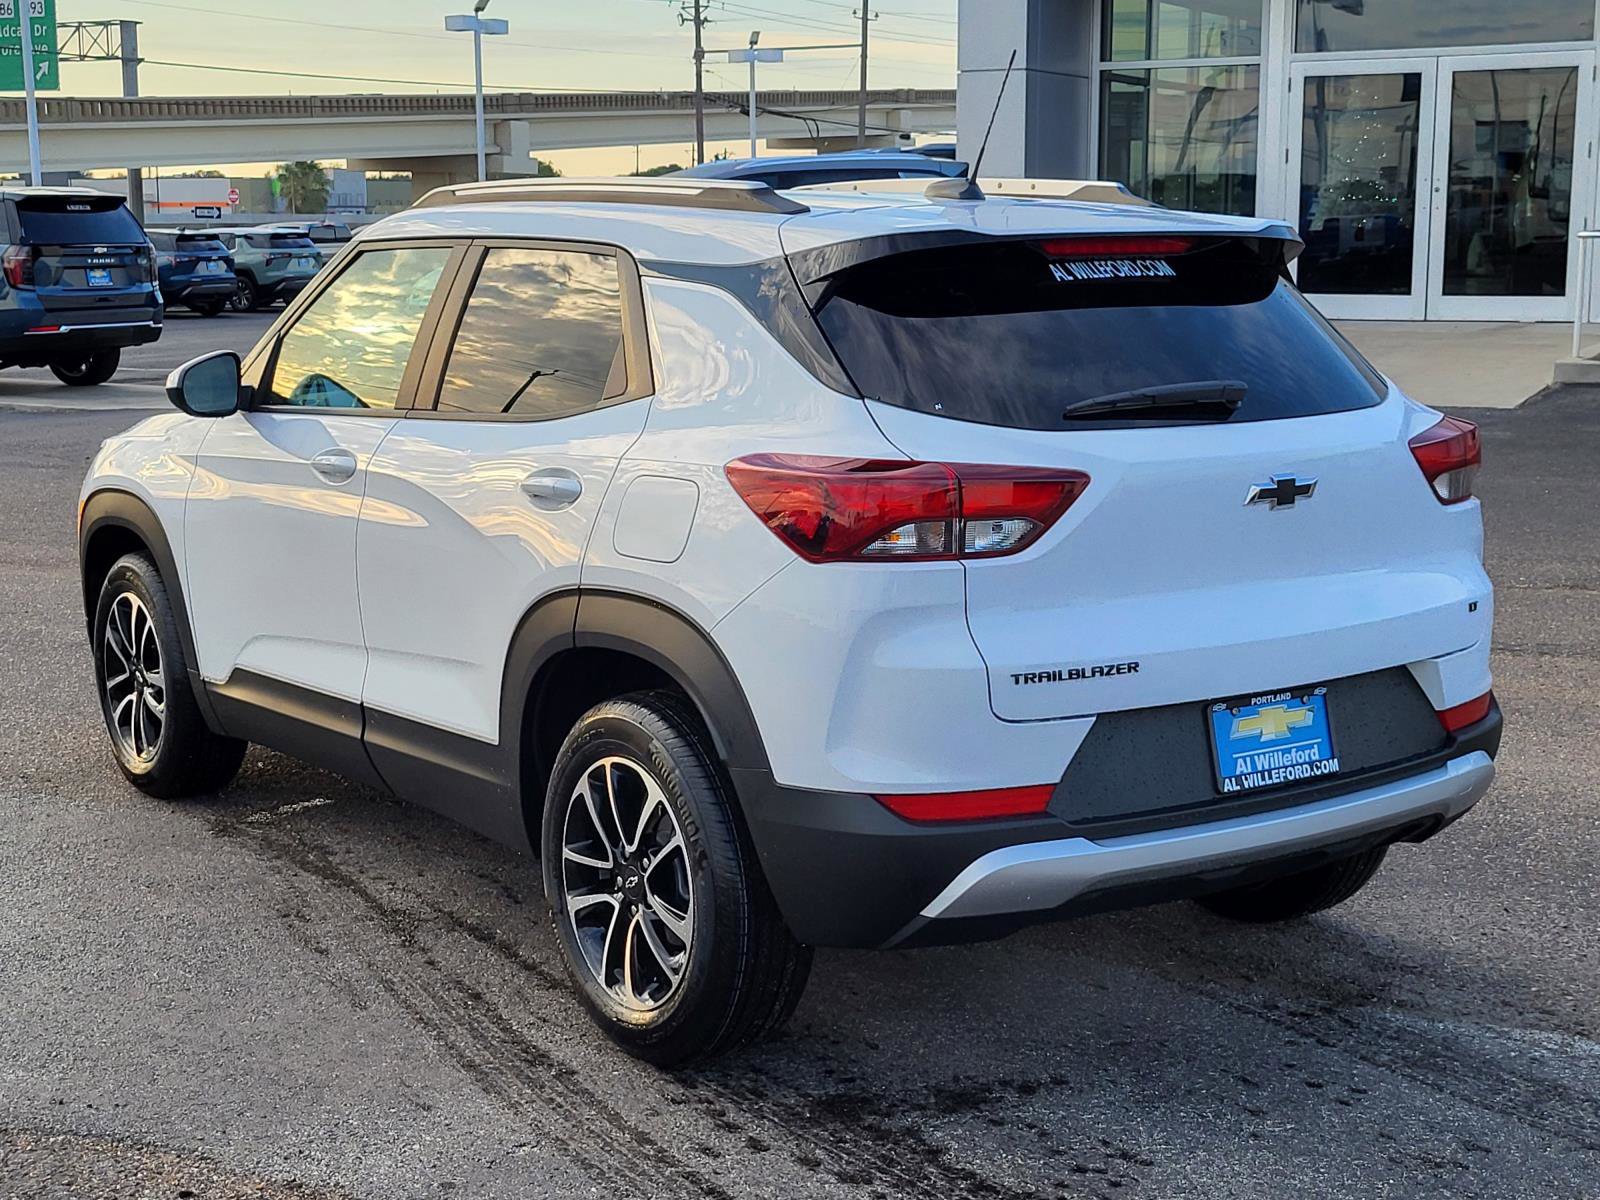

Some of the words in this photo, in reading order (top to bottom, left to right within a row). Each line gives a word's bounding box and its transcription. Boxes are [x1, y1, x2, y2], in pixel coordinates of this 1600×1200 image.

[29, 1, 44, 15] 93
[34, 24, 47, 36] Dr
[1049, 263, 1074, 282] AL
[1065, 259, 1177, 280] WILLEFORD.COM
[1010, 661, 1140, 686] TRAILBLAZER
[1251, 692, 1292, 706] PORTLAND
[1235, 756, 1251, 775] Al
[1253, 744, 1320, 772] Willeford
[1223, 777, 1241, 793] AL
[1241, 758, 1340, 789] WILLEFORD.COM
